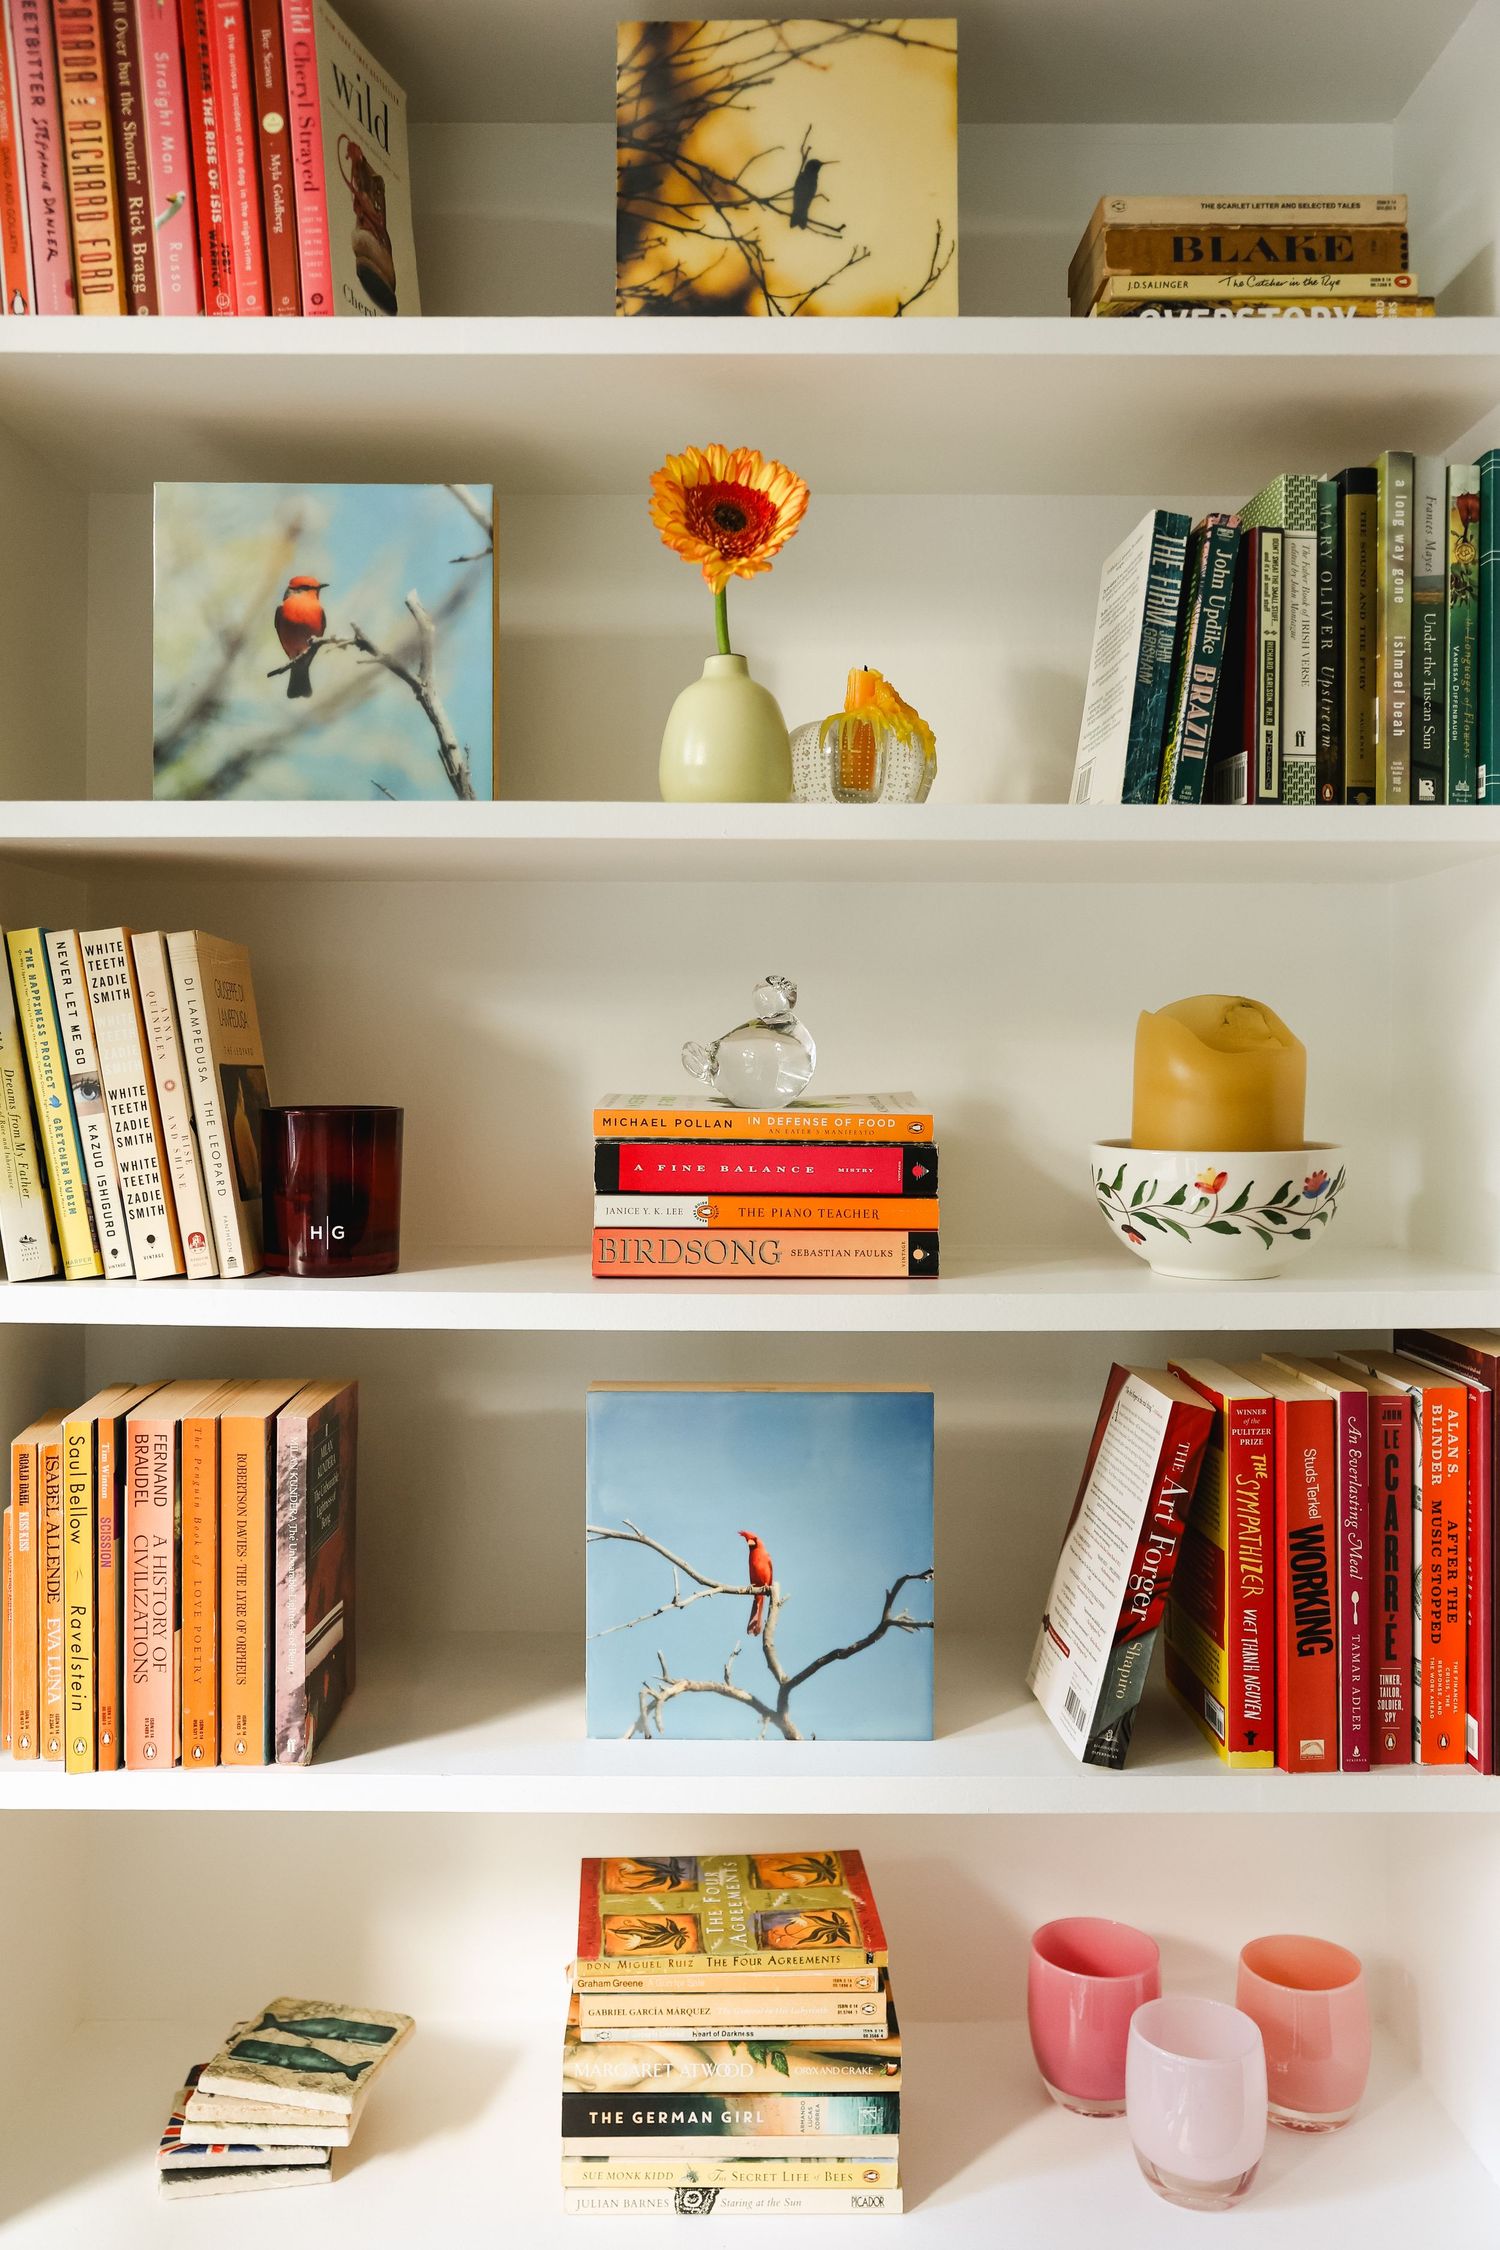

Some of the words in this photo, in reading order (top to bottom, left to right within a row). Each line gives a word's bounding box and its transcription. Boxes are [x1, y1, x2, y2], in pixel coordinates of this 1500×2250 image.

[114, 17, 129, 56] Over
[117, 62, 132, 86] but
[154, 52, 174, 126] Straight
[292, 41, 313, 107] Cheryl
[119, 91, 135, 116] the
[122, 121, 143, 185] Shoutin'
[161, 136, 175, 174] Man
[270, 154, 281, 181] Myla
[298, 116, 320, 191] Strayed
[68, 121, 109, 222] RICHARD
[129, 196, 146, 236] Rick
[273, 183, 286, 233] Goldberg
[1201, 202, 1214, 210] THE
[1216, 202, 1250, 210] SCARLET
[1251, 202, 1279, 210] LETTER
[1280, 202, 1296, 210] AND
[1298, 202, 1336, 210] SELECTED
[1337, 202, 1361, 210] TALES
[78, 238, 115, 295] FORD
[208, 230, 221, 288] WARRICK
[221, 242, 231, 275] JOBY
[1172, 236, 1354, 263] BLAKE
[132, 242, 148, 294] Bragg
[1394, 479, 1406, 487] a
[1392, 495, 1407, 526] long
[1424, 496, 1438, 535] Frances
[1319, 503, 1333, 559] MARY
[1392, 534, 1406, 561] way
[1152, 534, 1188, 571] THE
[1212, 549, 1234, 589] John
[1424, 538, 1437, 573] Mayes
[1145, 574, 1182, 627] FIRM
[1392, 569, 1406, 604] gone
[1202, 595, 1226, 655] Updike
[1320, 570, 1333, 649] OLIVER
[1155, 627, 1174, 663] JOHN
[1422, 613, 1437, 653] Under
[1138, 623, 1158, 685] GRISHAM
[1393, 636, 1406, 694] ishmael
[1422, 656, 1436, 676] the
[1181, 664, 1218, 761] BRAZIL
[1317, 666, 1335, 748] Upstream
[1422, 678, 1437, 722] Tuscan
[1393, 702, 1406, 737] beah
[1422, 724, 1437, 750] Sun
[24, 947, 35, 969] THE
[56, 941, 72, 986] NEVER
[85, 941, 124, 956] WHITE
[88, 957, 125, 971] TEETH
[92, 973, 128, 988] ZADIE
[93, 989, 131, 1004] SMITH
[184, 978, 195, 991] DI
[28, 974, 47, 1037] HAPPINESS
[65, 992, 78, 1017] LET
[70, 1024, 82, 1042] ME
[187, 999, 209, 1083] LAMPEDUSA
[40, 1040, 56, 1090] PROJECT
[75, 1048, 86, 1065] GO
[108, 1085, 146, 1101] WHITE
[112, 1101, 148, 1115] TEETH
[115, 1117, 150, 1132] ZADIE
[203, 1101, 216, 1126] THE
[602, 1117, 667, 1127] MICHAEL
[675, 1119, 733, 1128] POLLAN
[748, 1117, 760, 1125] IN
[768, 1117, 828, 1126] DEFENSE
[834, 1118, 852, 1126] OF
[858, 1118, 896, 1127] FOOD
[117, 1133, 153, 1148] SMITH
[88, 1124, 104, 1168] KAZUO
[97, 1175, 116, 1238] ISHIGURO
[120, 1157, 157, 1173] WHITE
[123, 1173, 159, 1188] TEETH
[208, 1134, 227, 1197] LEOPARD
[657, 1164, 706, 1172] FINE
[720, 1165, 815, 1173] BALANCE
[127, 1189, 162, 1205] ZADIE
[129, 1205, 165, 1220] SMITH
[738, 1207, 765, 1217] THE
[771, 1208, 812, 1218] PIANO
[818, 1208, 880, 1220] TEACHER
[598, 1238, 782, 1265] BIRDSONG
[790, 1249, 851, 1257] SEBASTIAN
[854, 1249, 893, 1257] FAULKS
[1231, 1428, 1271, 1436] PULITZER
[1348, 1416, 1362, 1444] An
[1382, 1410, 1402, 1420] JOHN
[1240, 1438, 1264, 1446] PRIZE
[1384, 1429, 1399, 1449] LE
[1431, 1404, 1442, 1485] BLINDER
[1447, 1409, 1459, 1459] ALAN
[69, 1436, 87, 1476] Saul
[134, 1434, 149, 1508] BRAUDEL
[153, 1434, 168, 1507] FERNAND
[1172, 1442, 1190, 1473] THE
[1250, 1453, 1268, 1479] THE
[1304, 1448, 1318, 1484] Studs
[1448, 1463, 1459, 1477] S.
[45, 1455, 60, 1517] ISABEL
[237, 1453, 248, 1517] ROBERTSON
[1154, 1475, 1189, 1525] Art
[1307, 1486, 1322, 1520] Terkel
[1344, 1449, 1363, 1529] Everlasting
[69, 1483, 88, 1544] Bellow
[1431, 1500, 1442, 1557] MUSIC
[152, 1535, 167, 1547] A
[237, 1520, 247, 1557] DAVIES
[1235, 1473, 1264, 1599] SYMPATHIZER
[1447, 1520, 1459, 1581] AFTER
[46, 1521, 61, 1604] ALLENDE
[1347, 1533, 1363, 1580] Meal
[237, 1565, 247, 1586] THE
[1129, 1531, 1177, 1622] Forger
[1288, 1523, 1334, 1658] WORKING
[133, 1534, 149, 1684] CIVILIZATIONS
[152, 1555, 167, 1640] HISTORY
[236, 1590, 247, 1617] LYRE
[1430, 1563, 1442, 1644] STOPPED
[1447, 1587, 1458, 1623] THE
[47, 1618, 61, 1651] EVA
[236, 1620, 247, 1634] OF
[1242, 1609, 1258, 1634] VIET
[70, 1606, 89, 1711] Ravelstein
[152, 1646, 167, 1673] OF
[236, 1636, 247, 1685] ORPHEUS
[1115, 1642, 1143, 1699] Shapiro
[1241, 1637, 1260, 1671] THANH
[1351, 1634, 1361, 1682] TAMAR
[47, 1656, 61, 1704] LUNA
[1244, 1674, 1262, 1721] NGUYEN
[1352, 1687, 1361, 1732] ADLER
[1384, 1712, 1396, 1723] SPY
[577, 1979, 611, 1988] Graham
[613, 1979, 644, 1987] Greene
[588, 2008, 627, 2016] GABRIEL
[628, 2006, 664, 2016] GARCÍA
[666, 2006, 712, 2018] MÁRQUEZ
[574, 2062, 673, 2077] MARGARET
[680, 2062, 754, 2077] ATWOOD
[589, 2111, 624, 2124] THE
[632, 2111, 713, 2124] GERMAN
[721, 2111, 765, 2124] GIRL
[851, 2196, 885, 2208] PICADOR
